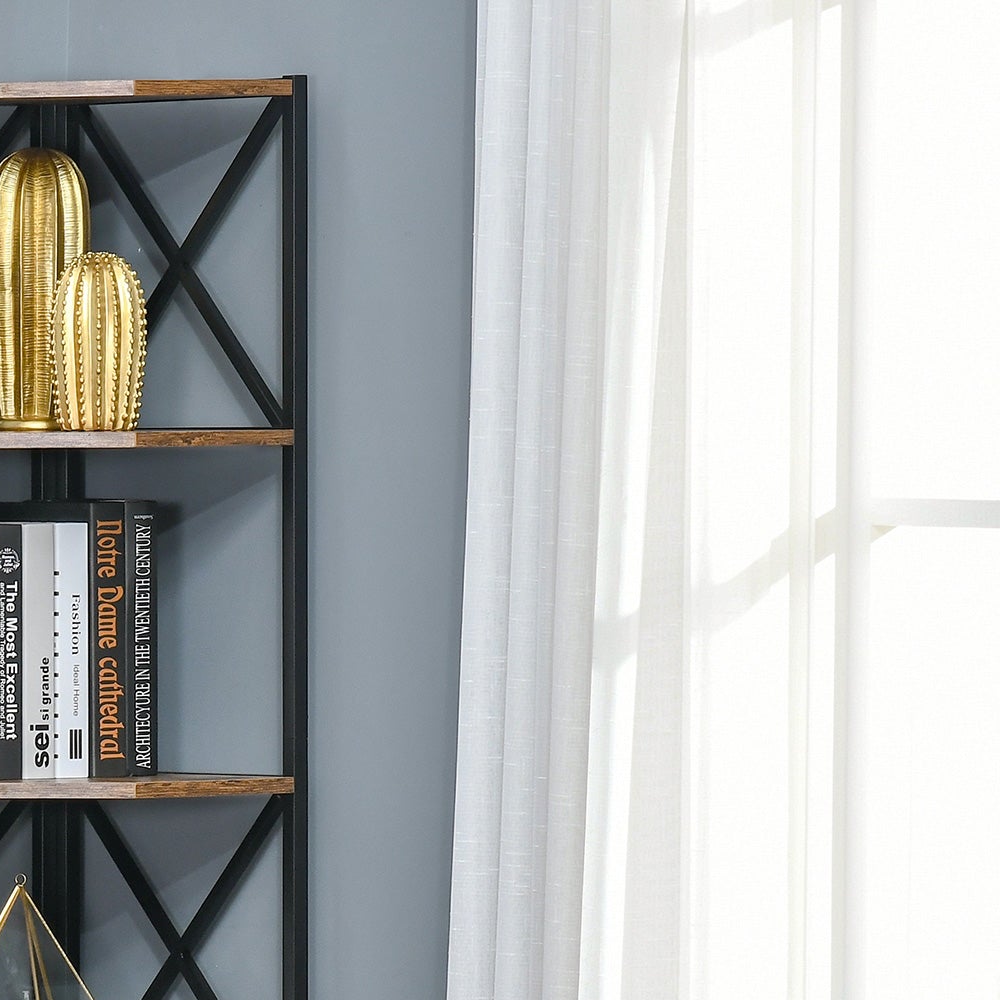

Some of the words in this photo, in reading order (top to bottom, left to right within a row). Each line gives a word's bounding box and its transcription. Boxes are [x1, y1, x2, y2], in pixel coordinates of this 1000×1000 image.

[96, 520, 123, 578] Notre
[136, 524, 151, 576] CENTURY
[6, 581, 18, 612] The
[97, 585, 124, 649] Dame
[135, 578, 150, 642] TWENTIETH
[6, 618, 18, 659] Most
[72, 594, 81, 655] Fashion
[135, 644, 150, 667] THE
[135, 669, 150, 682] IN
[6, 663, 18, 740] Excellent
[40, 657, 51, 705] grande
[40, 709, 49, 720] si
[98, 657, 126, 760] cathedral
[30, 725, 49, 768] sei
